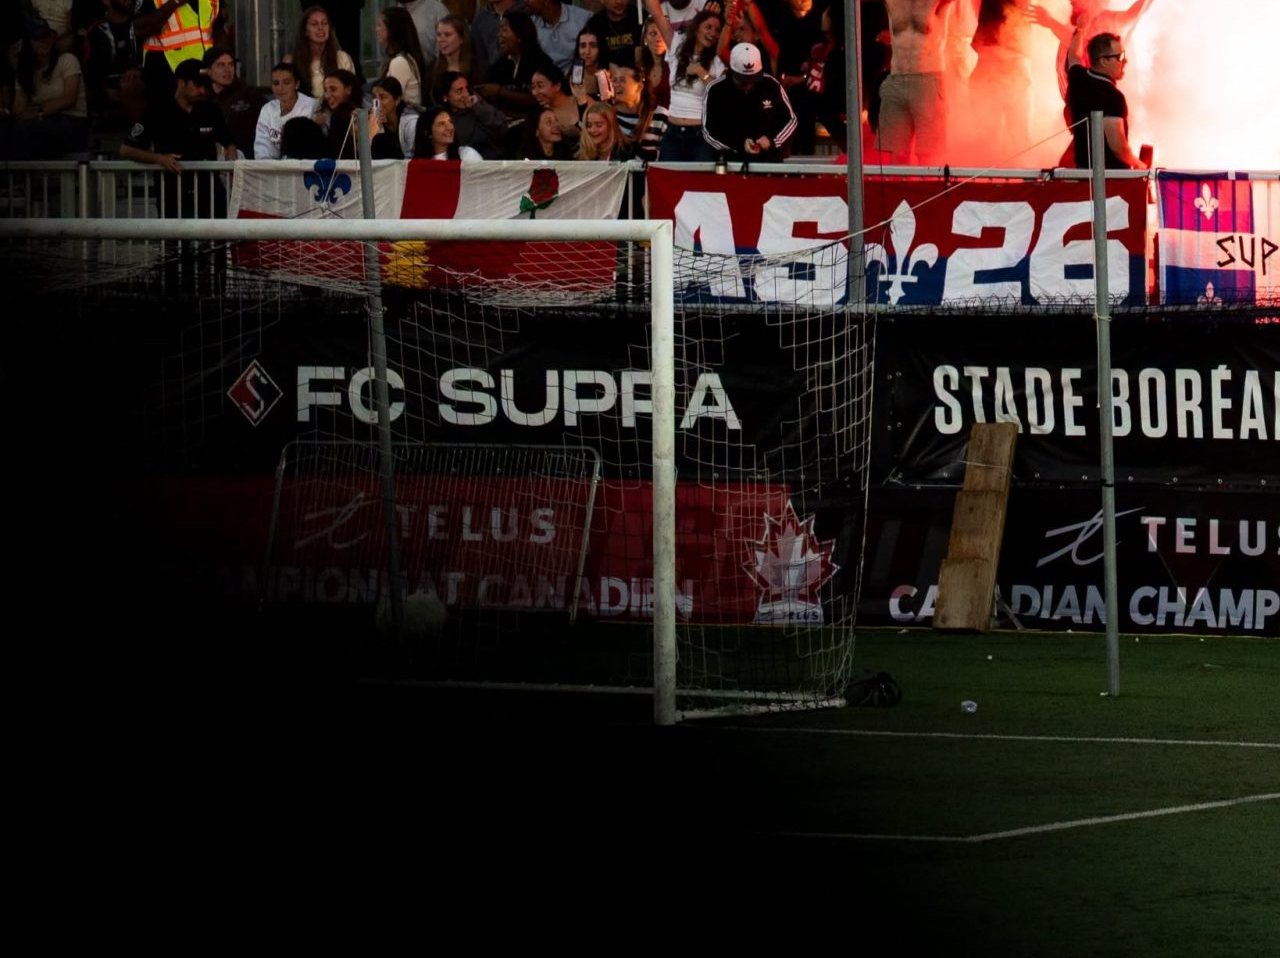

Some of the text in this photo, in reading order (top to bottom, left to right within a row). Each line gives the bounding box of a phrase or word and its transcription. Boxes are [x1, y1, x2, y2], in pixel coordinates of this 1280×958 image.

[674, 191, 1130, 305] AS 26
[296, 365, 406, 425] FC
[934, 364, 1087, 436] STADE
[395, 504, 556, 544] TELUS
[889, 583, 1108, 625] CADIAN
